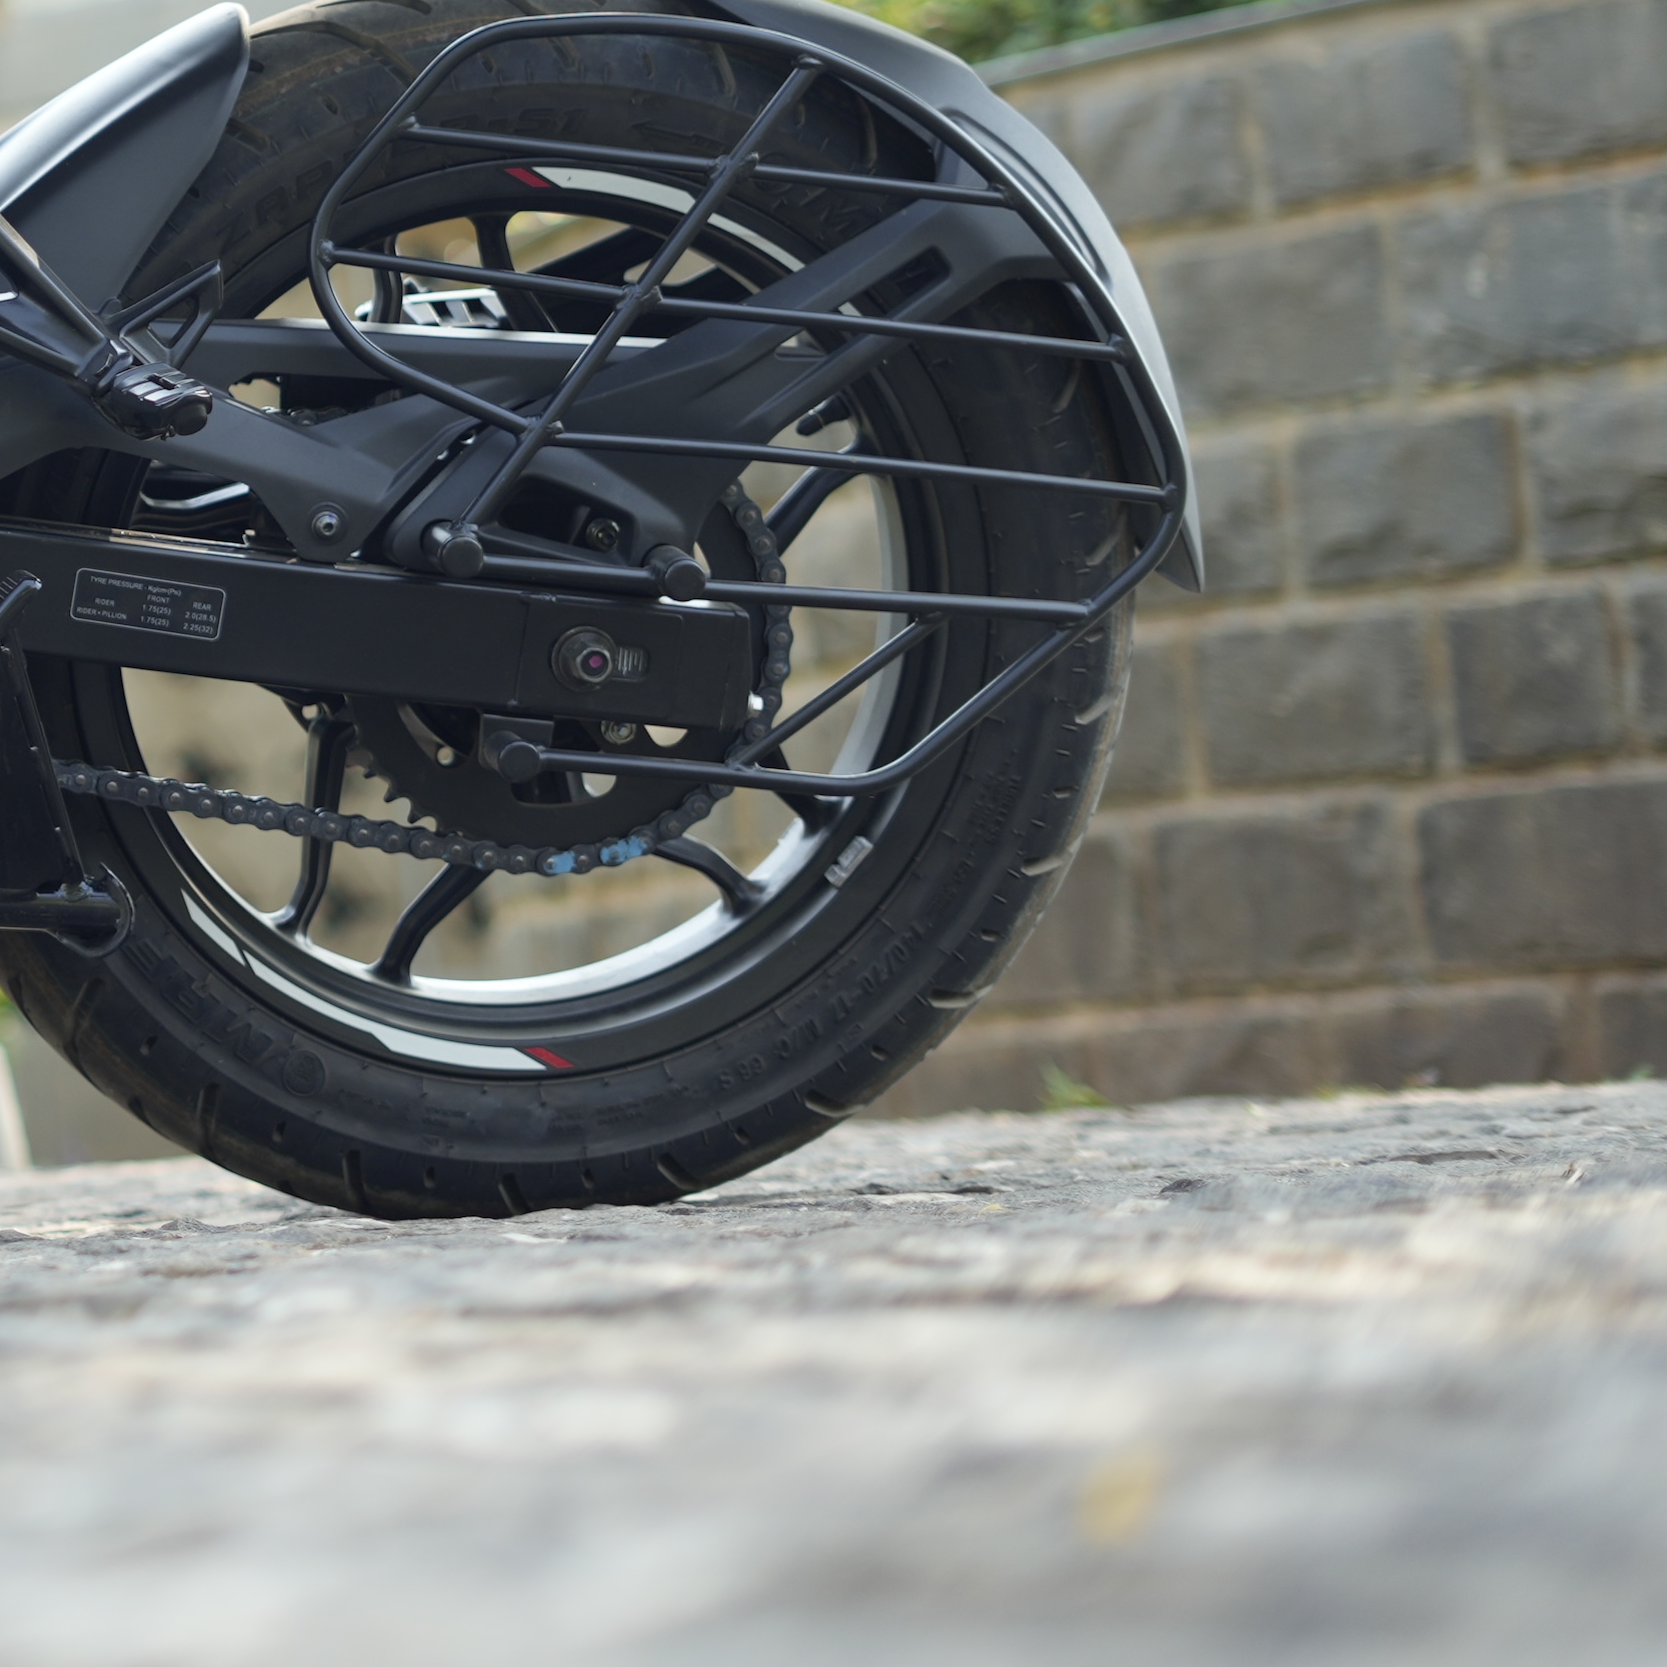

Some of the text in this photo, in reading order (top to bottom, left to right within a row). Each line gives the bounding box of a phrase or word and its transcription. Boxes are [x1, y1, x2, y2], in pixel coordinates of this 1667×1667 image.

[90, 575, 107, 585] TYRE
[108, 578, 144, 590] PRESSURE
[94, 597, 115, 607] RIDER
[147, 595, 212, 611] FRONT REAR
[121, 937, 274, 1066] MRF
